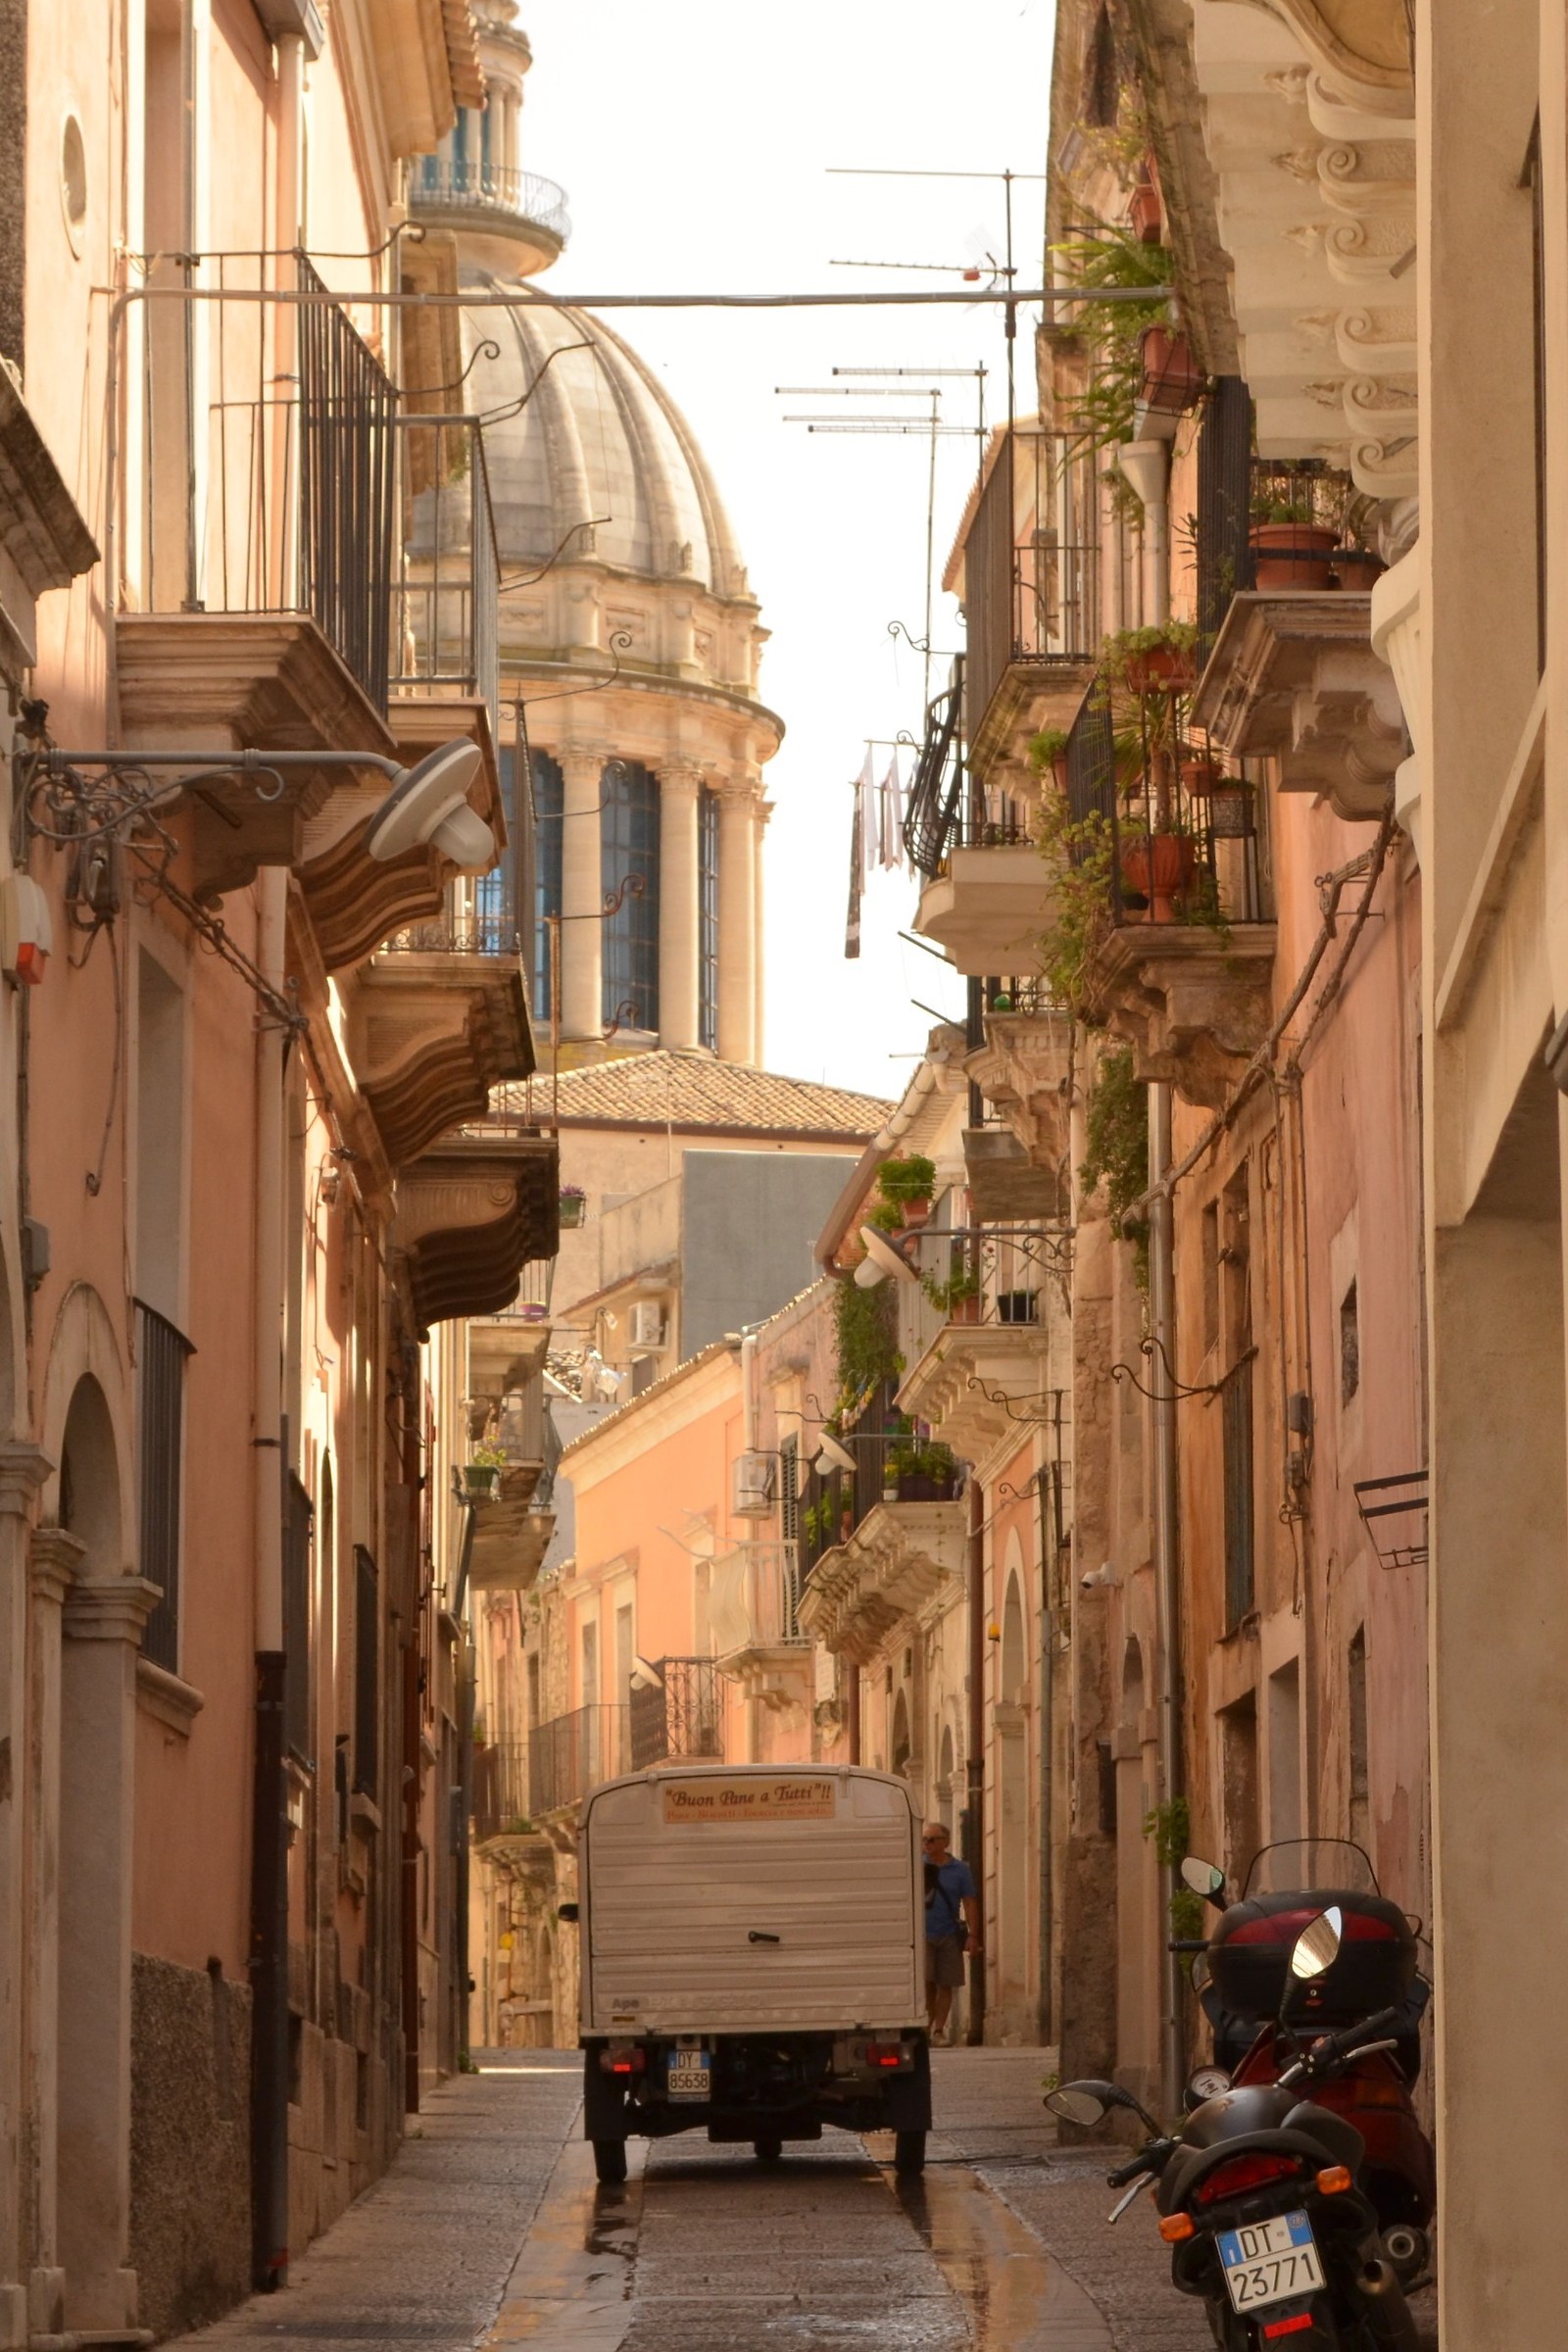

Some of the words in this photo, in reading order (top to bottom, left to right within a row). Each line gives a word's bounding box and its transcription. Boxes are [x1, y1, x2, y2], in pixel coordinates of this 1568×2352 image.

[719, 1789, 755, 1806] Pane
[760, 1792, 770, 1804] a
[612, 1997, 640, 2012] Ape
[677, 2052, 694, 2068] DY
[669, 2073, 709, 2088] 85638
[1240, 2224, 1272, 2259] DT
[1233, 2252, 1315, 2303] 23771
